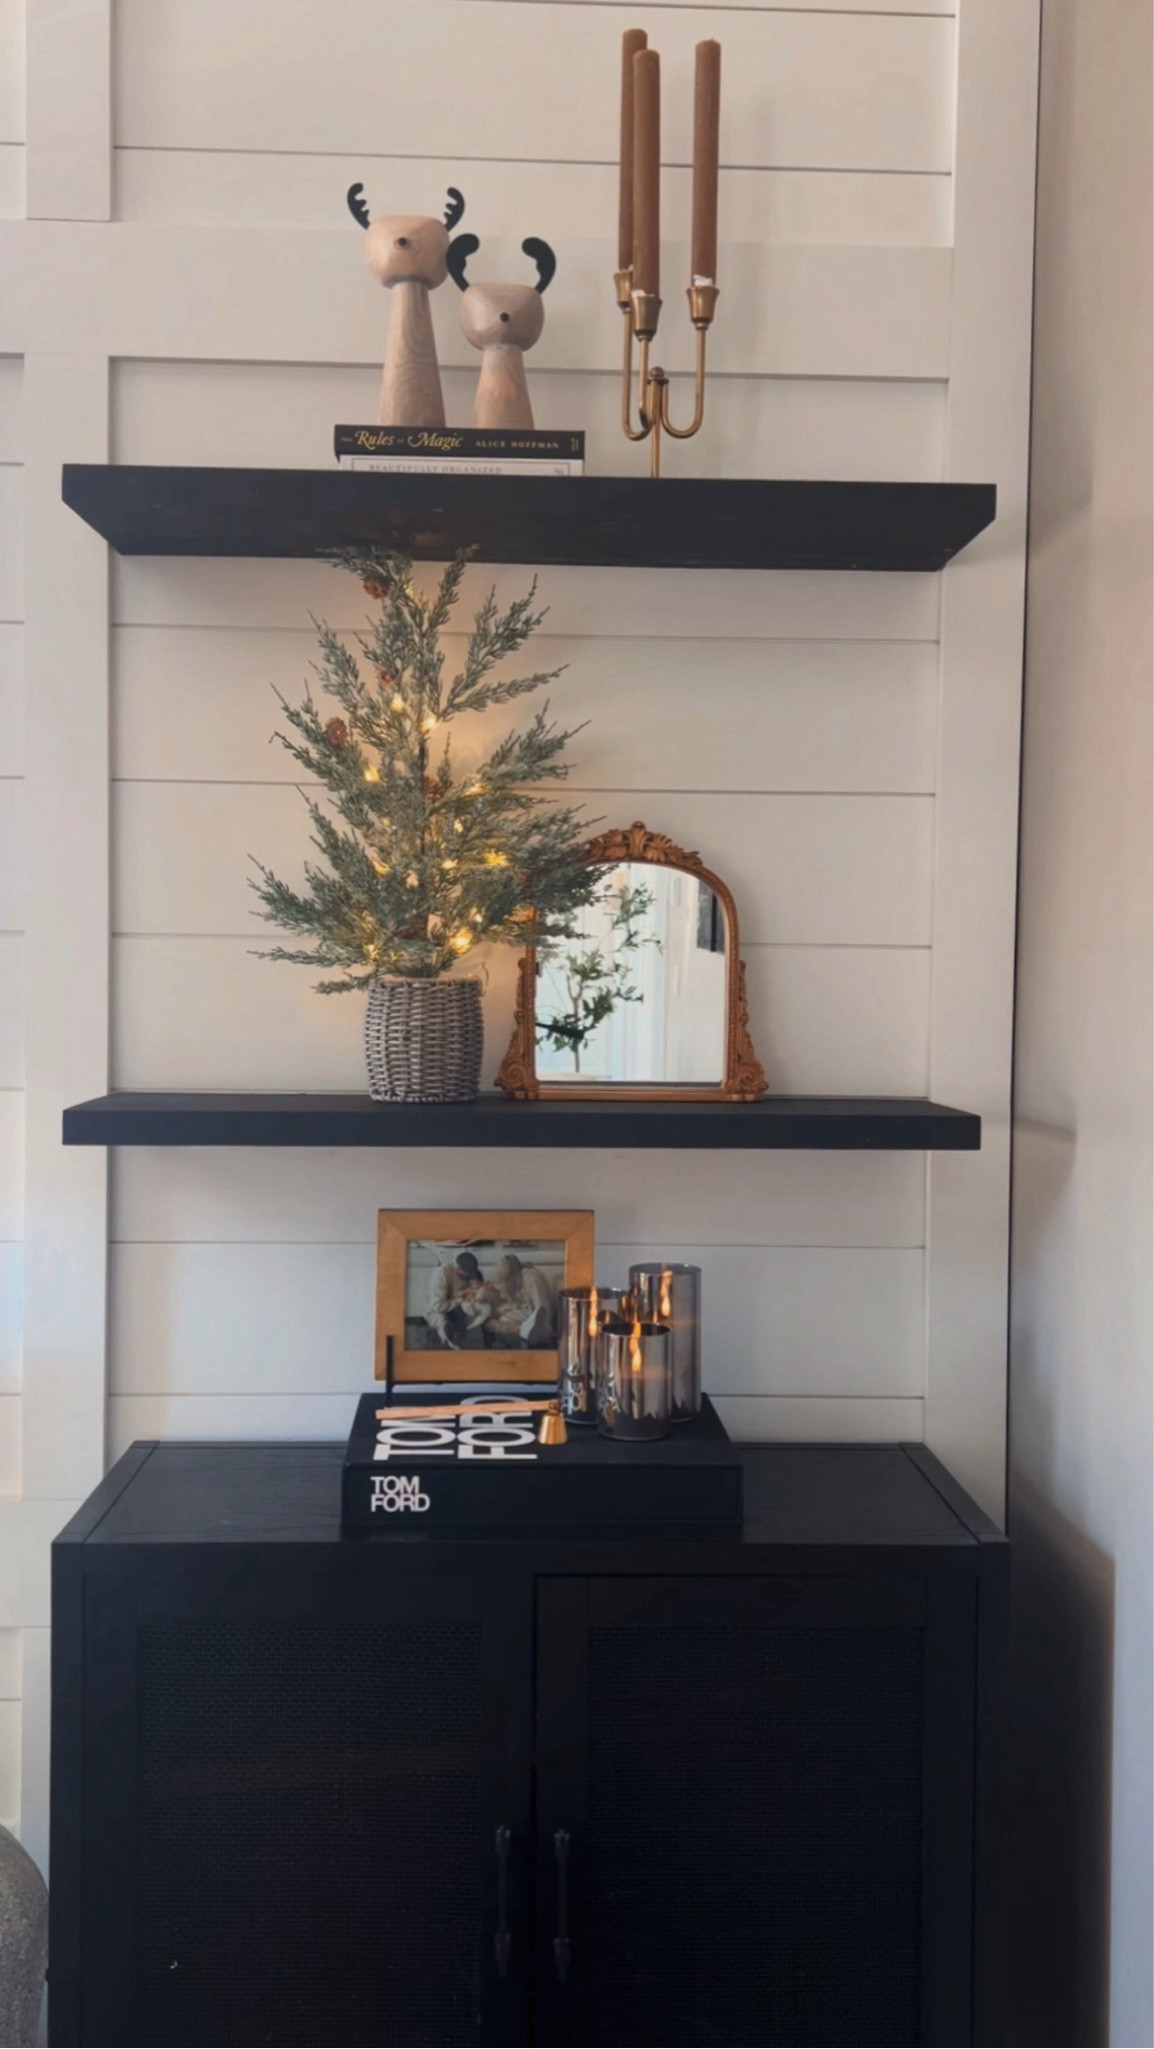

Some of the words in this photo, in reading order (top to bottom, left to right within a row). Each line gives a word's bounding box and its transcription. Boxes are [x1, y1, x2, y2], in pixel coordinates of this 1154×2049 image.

[355, 431, 395, 450] Rules
[407, 432, 463, 450] Magic
[475, 440, 506, 448] ALICE
[511, 441, 559, 449] HOFFMAN
[441, 466, 502, 474] ORGANIZED
[370, 1476, 420, 1495] TOM
[371, 1493, 430, 1512] FORD
